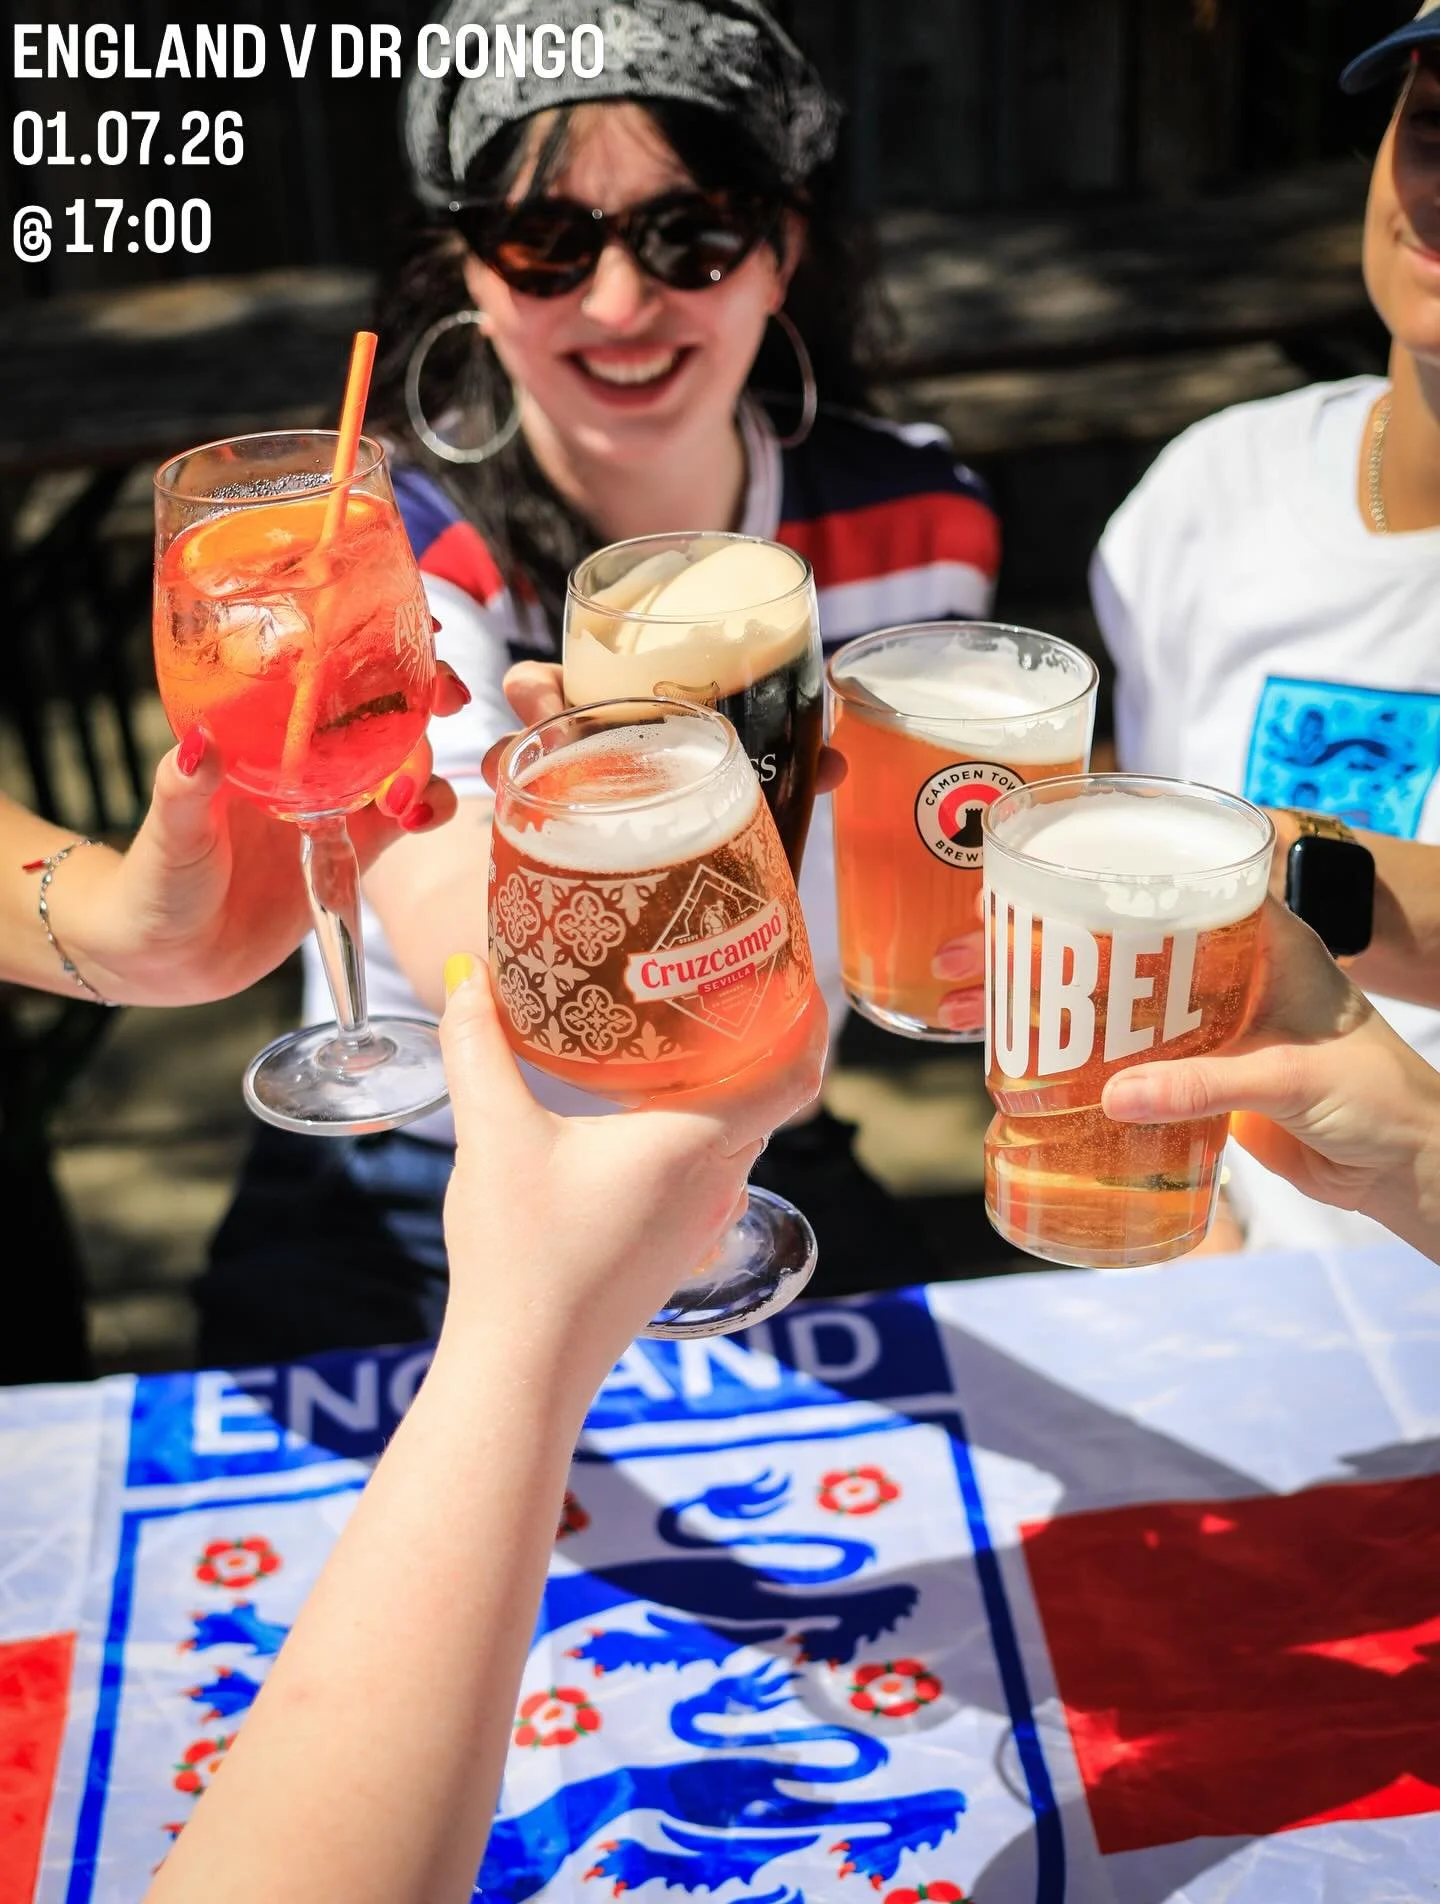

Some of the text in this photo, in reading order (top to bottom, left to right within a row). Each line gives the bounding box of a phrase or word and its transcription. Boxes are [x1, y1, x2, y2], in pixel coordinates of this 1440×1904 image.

[925, 769, 1017, 807] CAMDEN TOW
[935, 839, 984, 863] BREW
[640, 911, 783, 990] Cruzcampo
[703, 967, 752, 993] SEVILLA
[191, 1308, 881, 1457] ENAND
